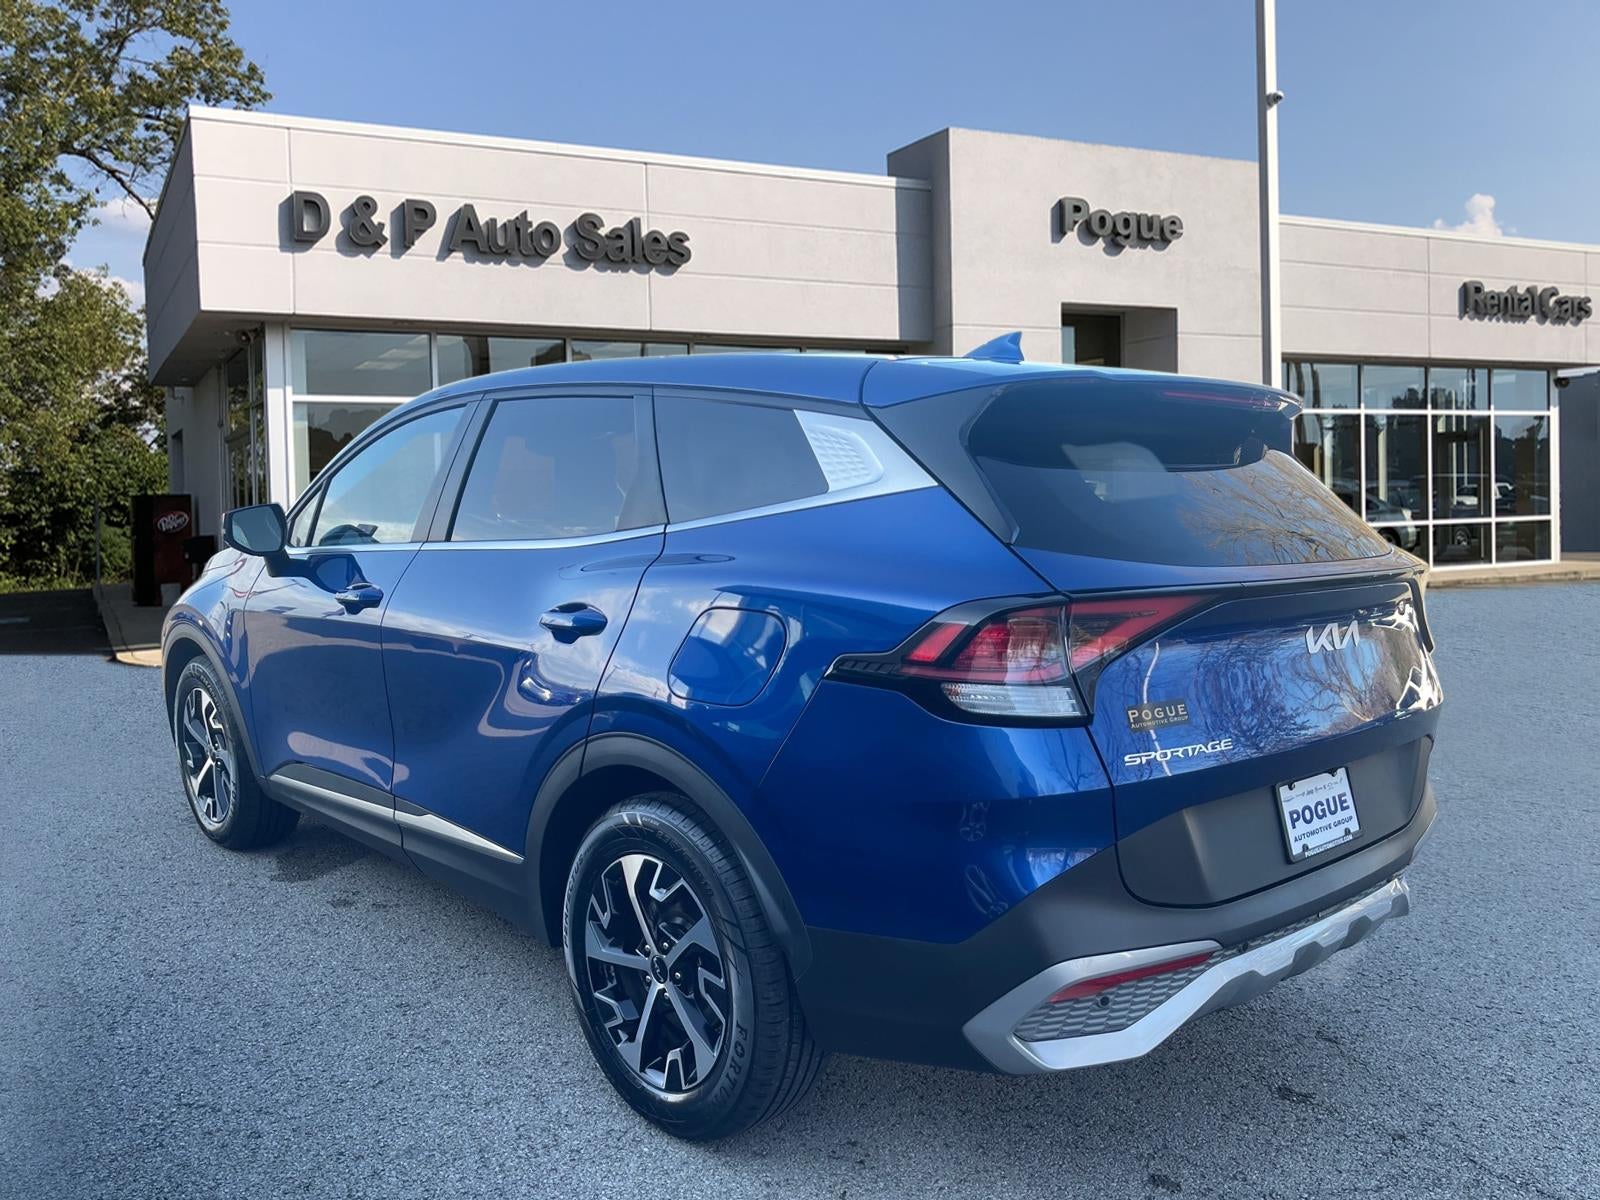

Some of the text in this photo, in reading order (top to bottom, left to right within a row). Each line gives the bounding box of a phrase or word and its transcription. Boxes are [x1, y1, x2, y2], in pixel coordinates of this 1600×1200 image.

[291, 190, 692, 268] D & P Auto Sales
[1058, 197, 1184, 247] Pogue
[1462, 280, 1592, 321] Rental Cars
[1127, 704, 1188, 723] POGUE
[1131, 715, 1189, 729] AUTOMOTIVE GROUP
[1124, 738, 1234, 766] SPORTAGE
[1288, 792, 1350, 829] POGUE
[1294, 815, 1353, 843] AUTOMOTIVE GROUP
